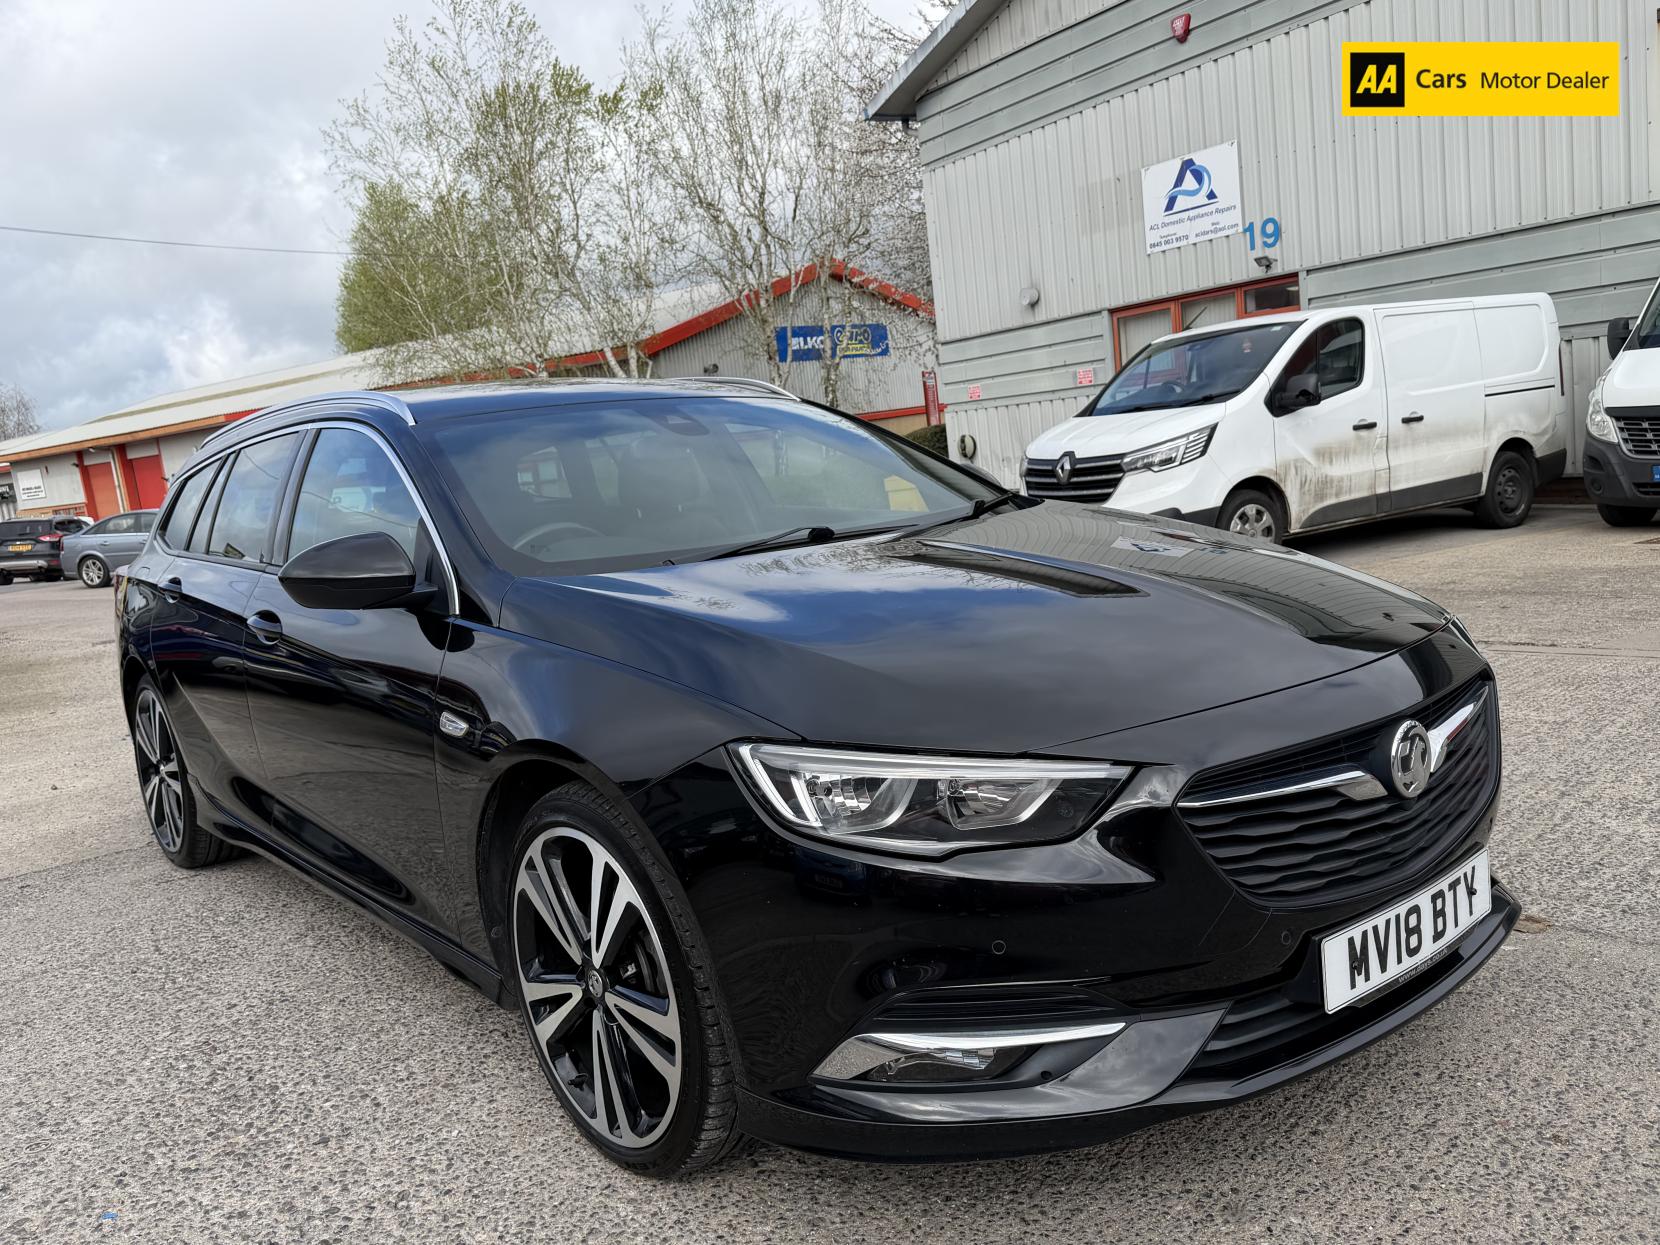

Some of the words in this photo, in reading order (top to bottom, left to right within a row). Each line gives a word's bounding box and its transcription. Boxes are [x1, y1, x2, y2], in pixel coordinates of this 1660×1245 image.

[1149, 223, 1160, 231] ACL
[1160, 217, 1186, 229] Domestic
[1186, 210, 1214, 223] Appliance
[1214, 204, 1237, 216] Repairs
[1243, 217, 1281, 251] 19
[1347, 904, 1423, 991] MV18
[1431, 865, 1476, 944] BTY
